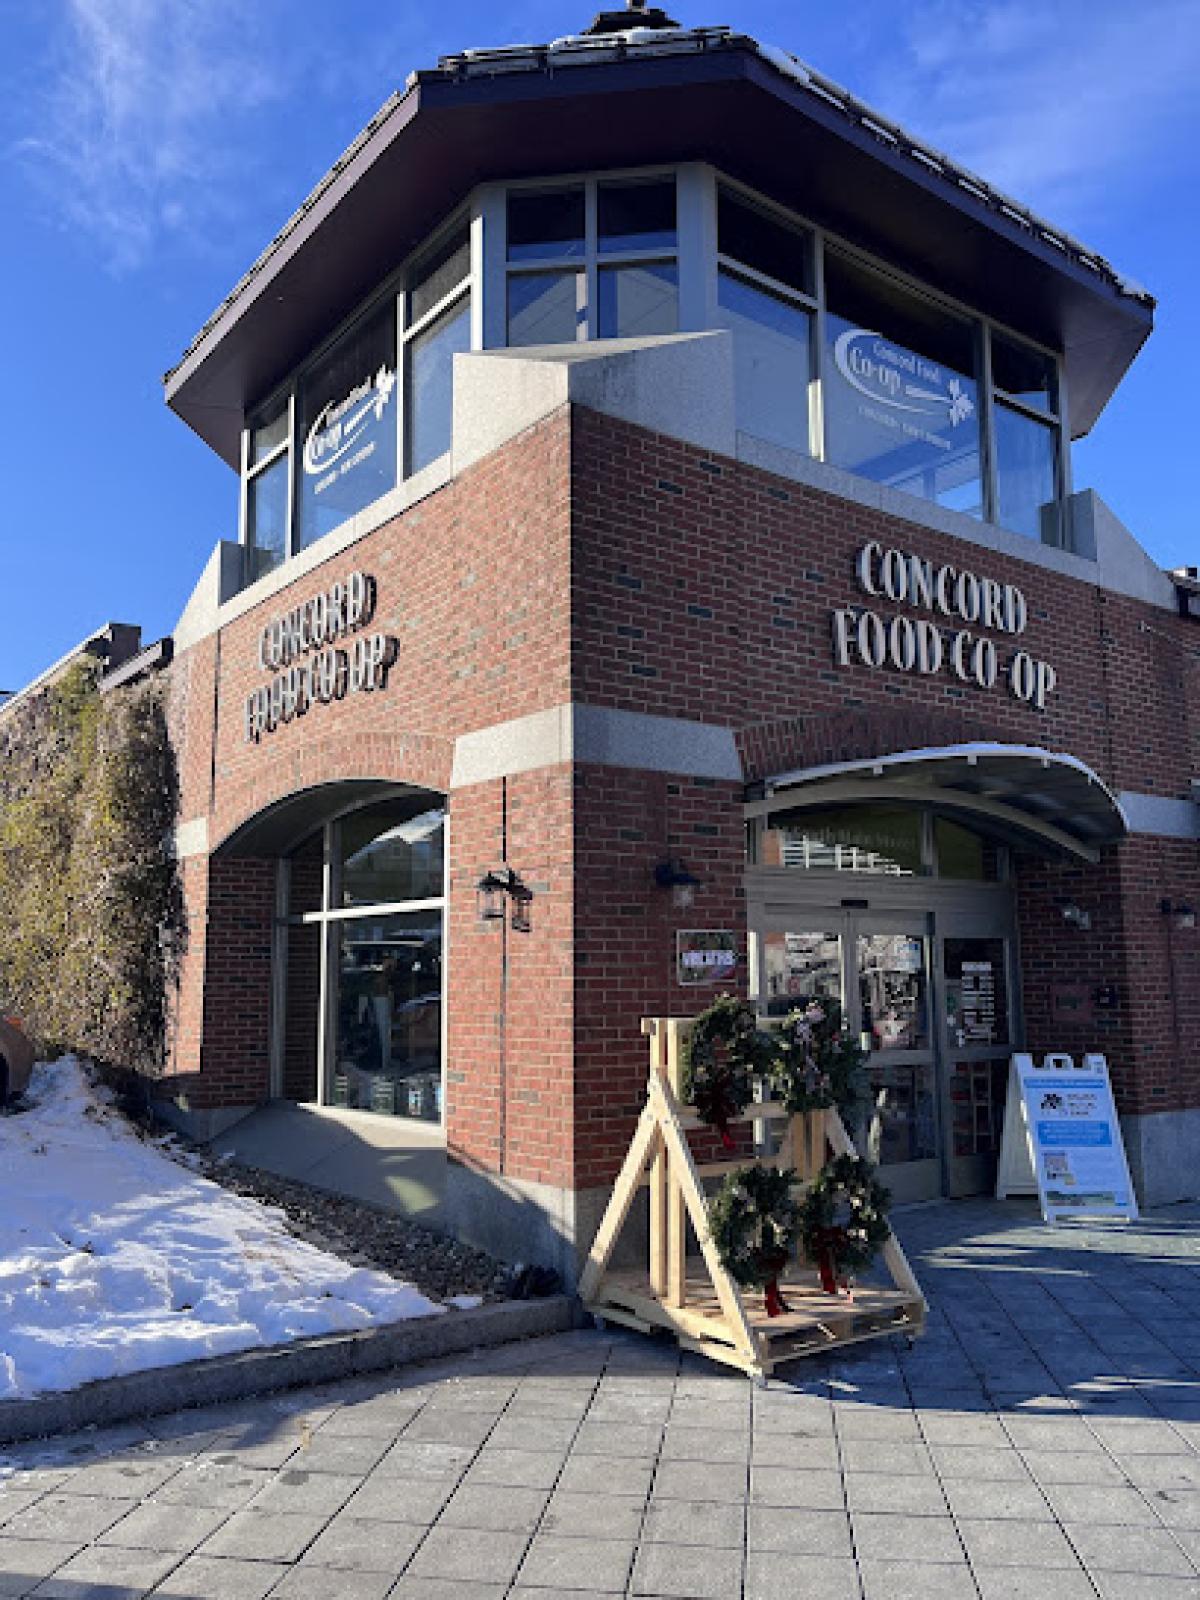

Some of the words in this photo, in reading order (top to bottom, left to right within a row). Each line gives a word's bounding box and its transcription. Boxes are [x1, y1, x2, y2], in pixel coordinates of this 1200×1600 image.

[857, 541, 1027, 634] CONCORD
[829, 608, 943, 674] FOOD
[953, 629, 1057, 709] CO-OP
